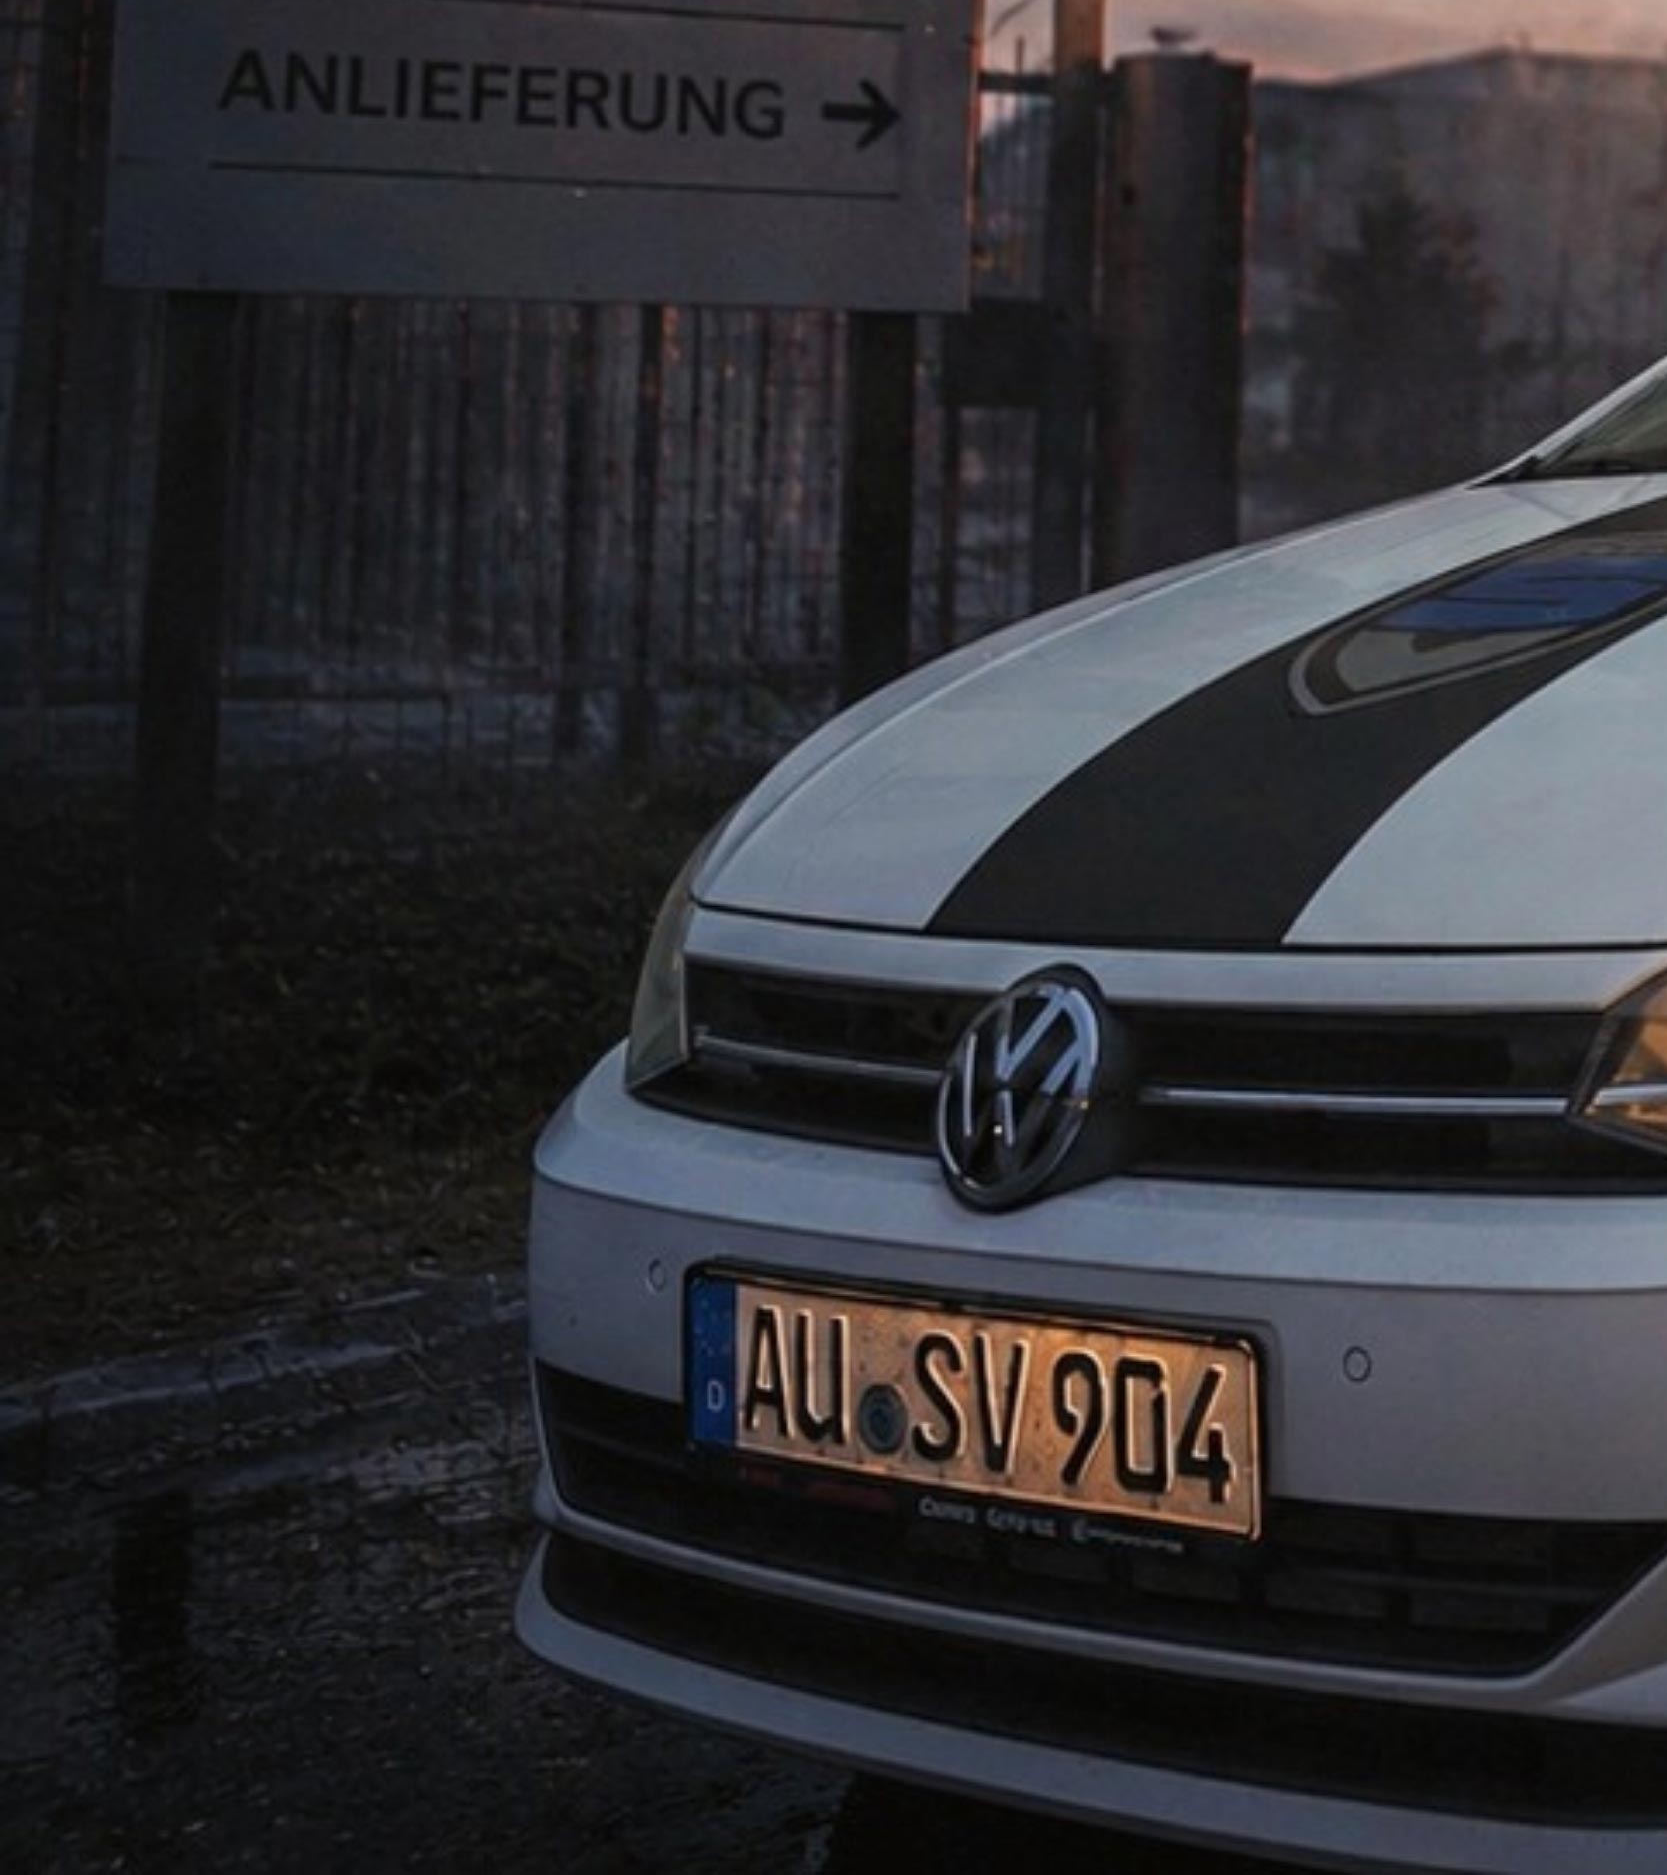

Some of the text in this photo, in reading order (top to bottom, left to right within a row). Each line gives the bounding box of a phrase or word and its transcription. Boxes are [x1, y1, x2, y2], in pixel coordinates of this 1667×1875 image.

[218, 49, 787, 142] ANLIEFERUNG
[706, 1379, 725, 1413] D
[744, 1304, 1235, 1503] AU SV 904
